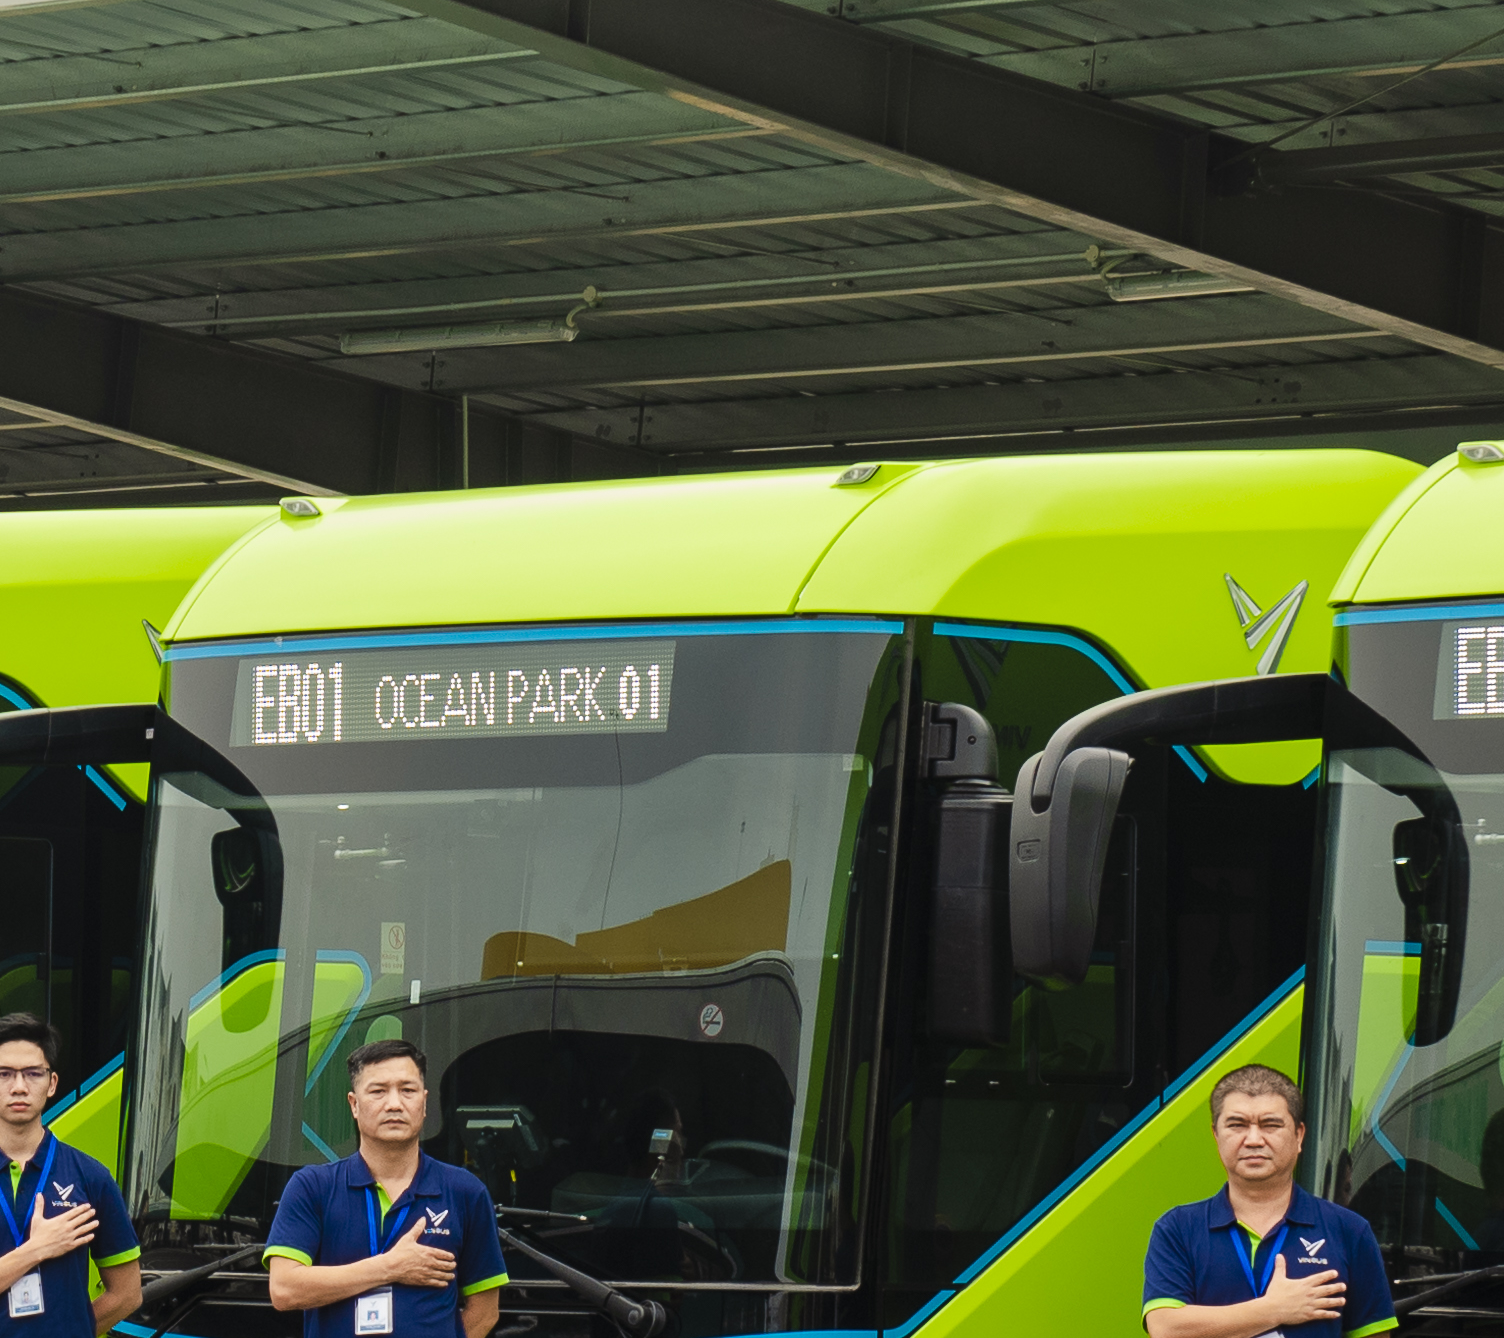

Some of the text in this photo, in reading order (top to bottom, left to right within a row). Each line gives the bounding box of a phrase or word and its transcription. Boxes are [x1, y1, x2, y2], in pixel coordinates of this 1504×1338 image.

[251, 661, 660, 744] EB01 OCEAN PARK 01
